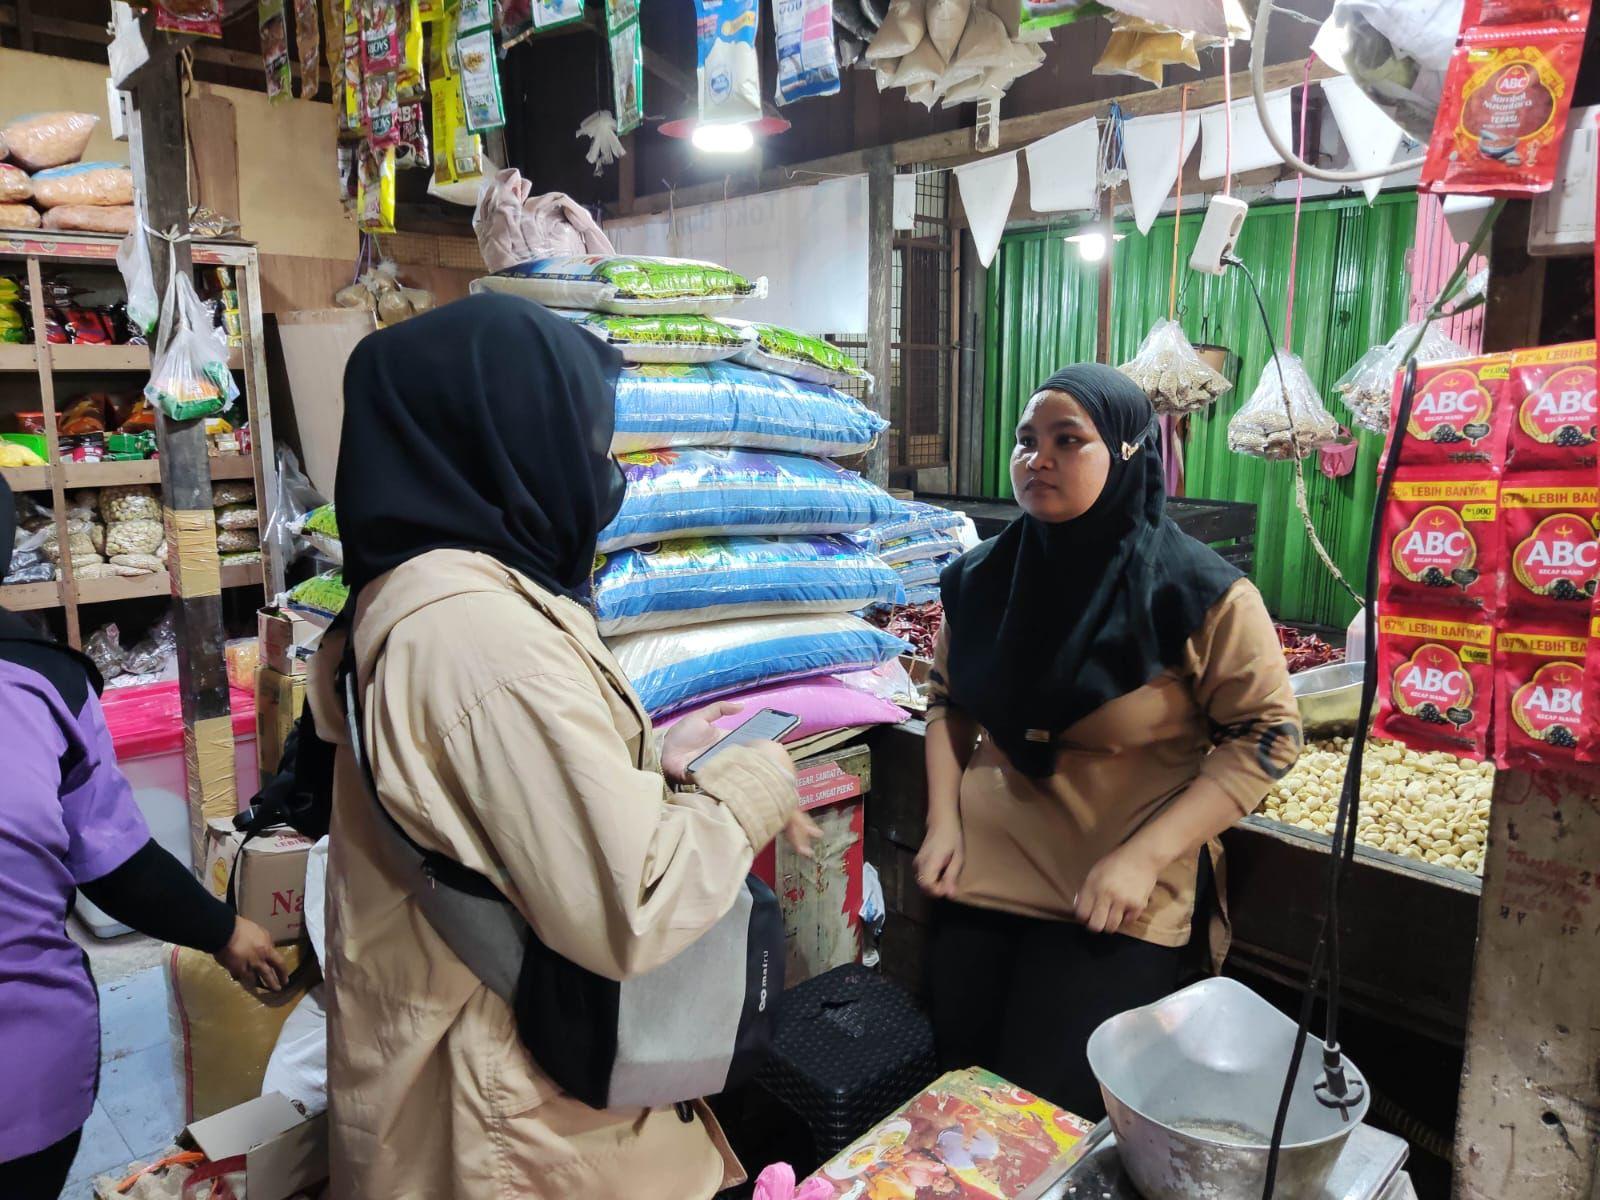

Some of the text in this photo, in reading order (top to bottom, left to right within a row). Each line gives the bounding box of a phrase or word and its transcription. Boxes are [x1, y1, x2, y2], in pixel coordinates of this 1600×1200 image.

[1500, 77, 1527, 89] ABC
[1414, 389, 1479, 415] ABC
[1411, 486, 1441, 497] LEBIH
[1445, 485, 1487, 497] BANYAK
[1531, 492, 1568, 504] LEBIH
[1572, 492, 1597, 503] BAN
[1402, 531, 1465, 557] ABC
[1525, 540, 1598, 567] ABC
[1408, 623, 1438, 635] LEBIH
[1529, 640, 1566, 652] LEBIH
[1400, 665, 1463, 695] ABC
[271, 889, 305, 917] Na
